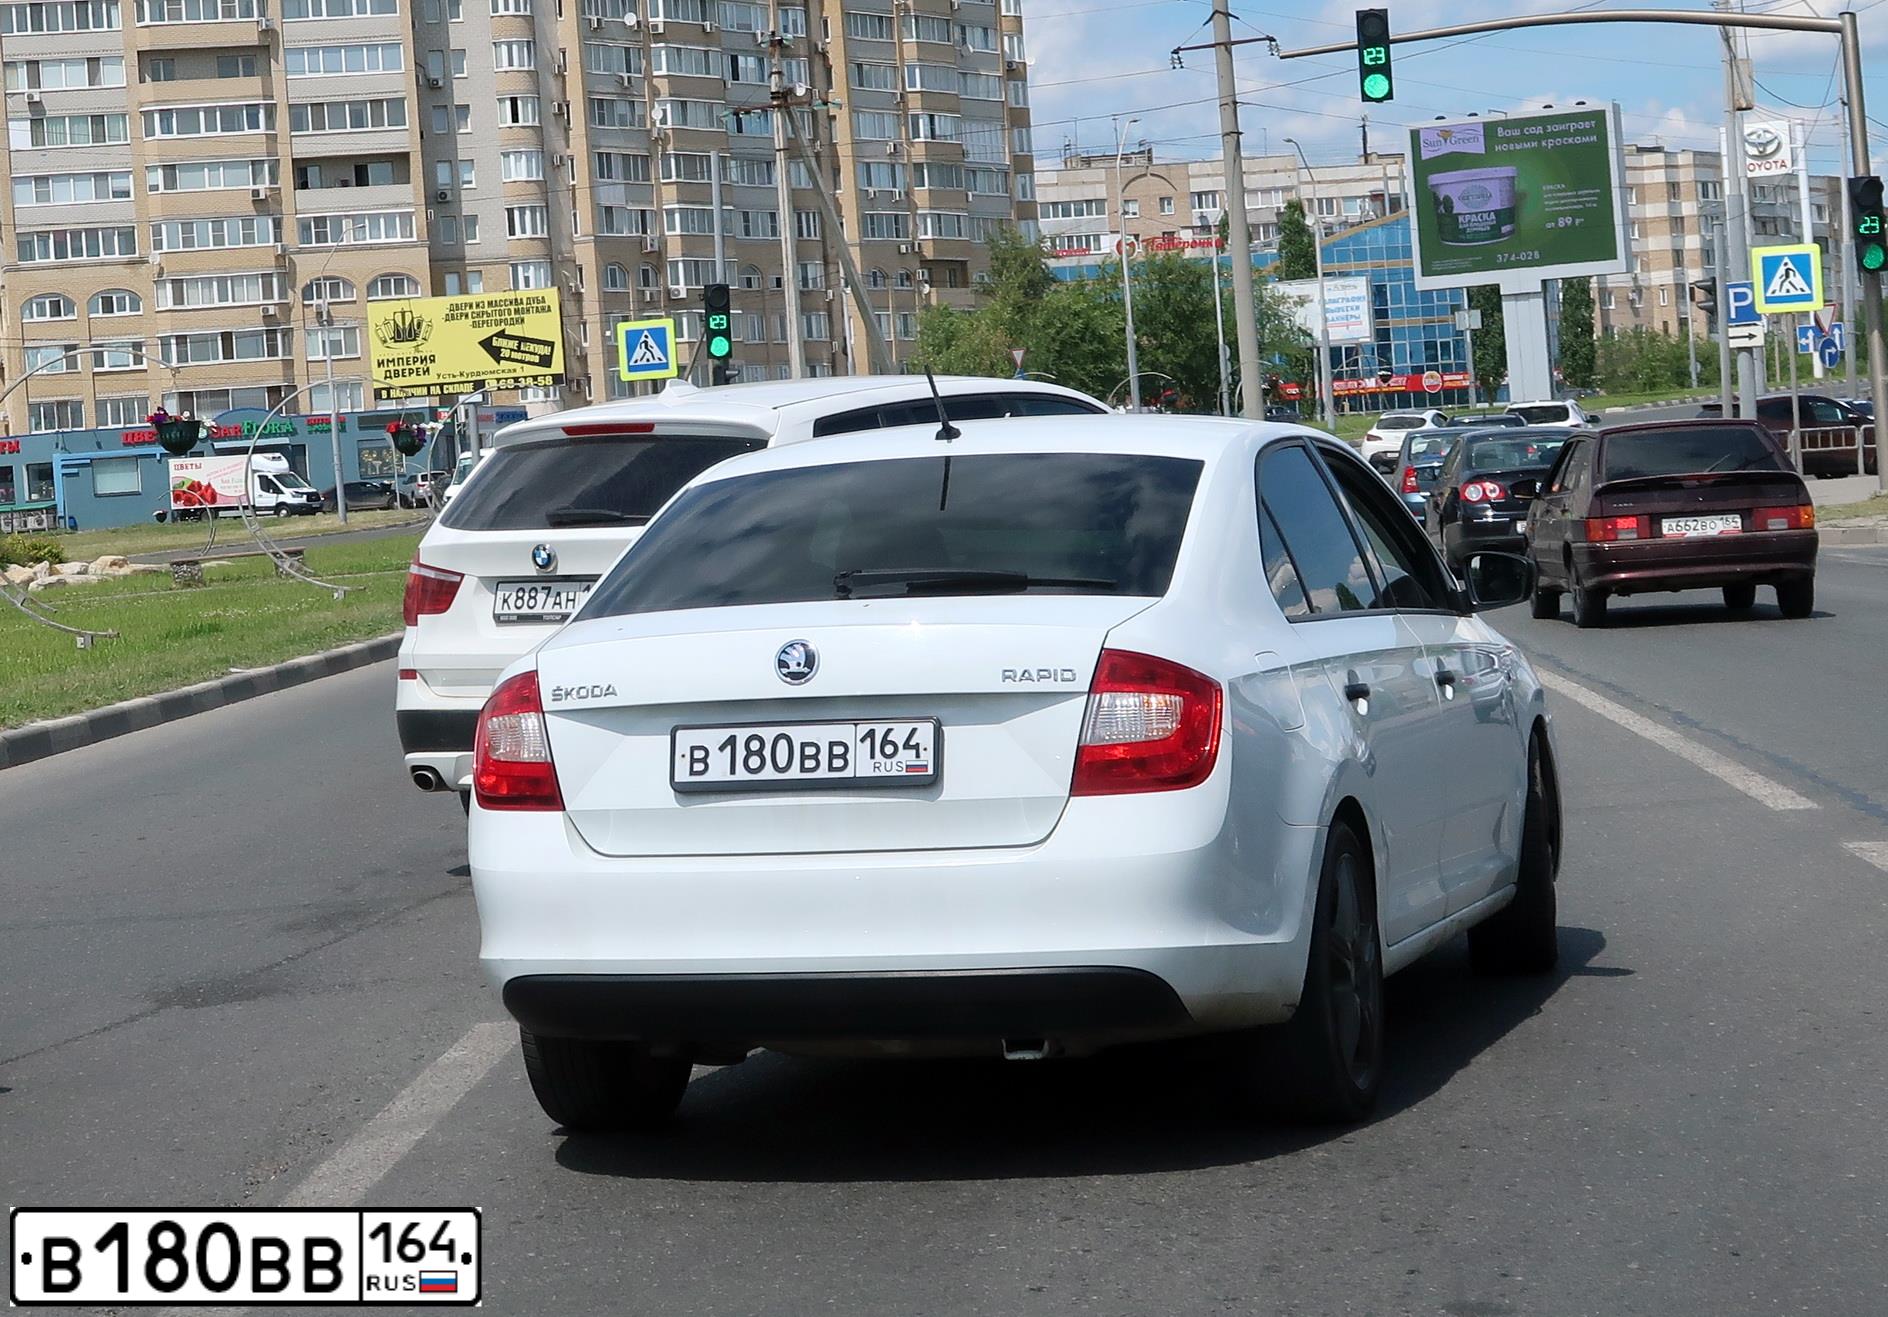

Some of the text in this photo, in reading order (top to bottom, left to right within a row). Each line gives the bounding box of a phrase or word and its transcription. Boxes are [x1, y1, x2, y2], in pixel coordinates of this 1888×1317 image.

[1497, 121, 1596, 137] Ваш сад заиграет
[1423, 135, 1479, 148] Sun Green
[1495, 135, 1598, 152] новыми красками
[1746, 159, 1788, 172] OYOTA
[1458, 211, 1497, 224] КРАСКА
[1558, 216, 1572, 227] 89
[475, 301, 486, 309] ИЗ
[487, 298, 524, 308] МАССИВА
[526, 296, 546, 306] ДУБА
[1729, 287, 1753, 319] P
[471, 308, 512, 319] СКРЫТОГО
[514, 305, 552, 316] МОНТАЖА
[492, 337, 519, 350] БЛИЖЕ
[500, 348, 511, 358] 20
[377, 354, 436, 368] ИМПЕРИЯ
[384, 364, 430, 380] ДВЕРЕЙ
[436, 367, 517, 380] Усть-Курдюмская
[381, 389, 388, 399] В
[429, 385, 441, 395] НА
[443, 382, 475, 394] СКЛАДЕ
[121, 431, 158, 445] ЦВЕ
[173, 463, 202, 471] ЦВЕТЫ
[501, 586, 577, 611] К887АН
[1001, 669, 1077, 682] RAPID
[551, 684, 618, 701] ŠKODA
[689, 727, 921, 776] В180ВВ 164
[873, 761, 904, 773] RUS
